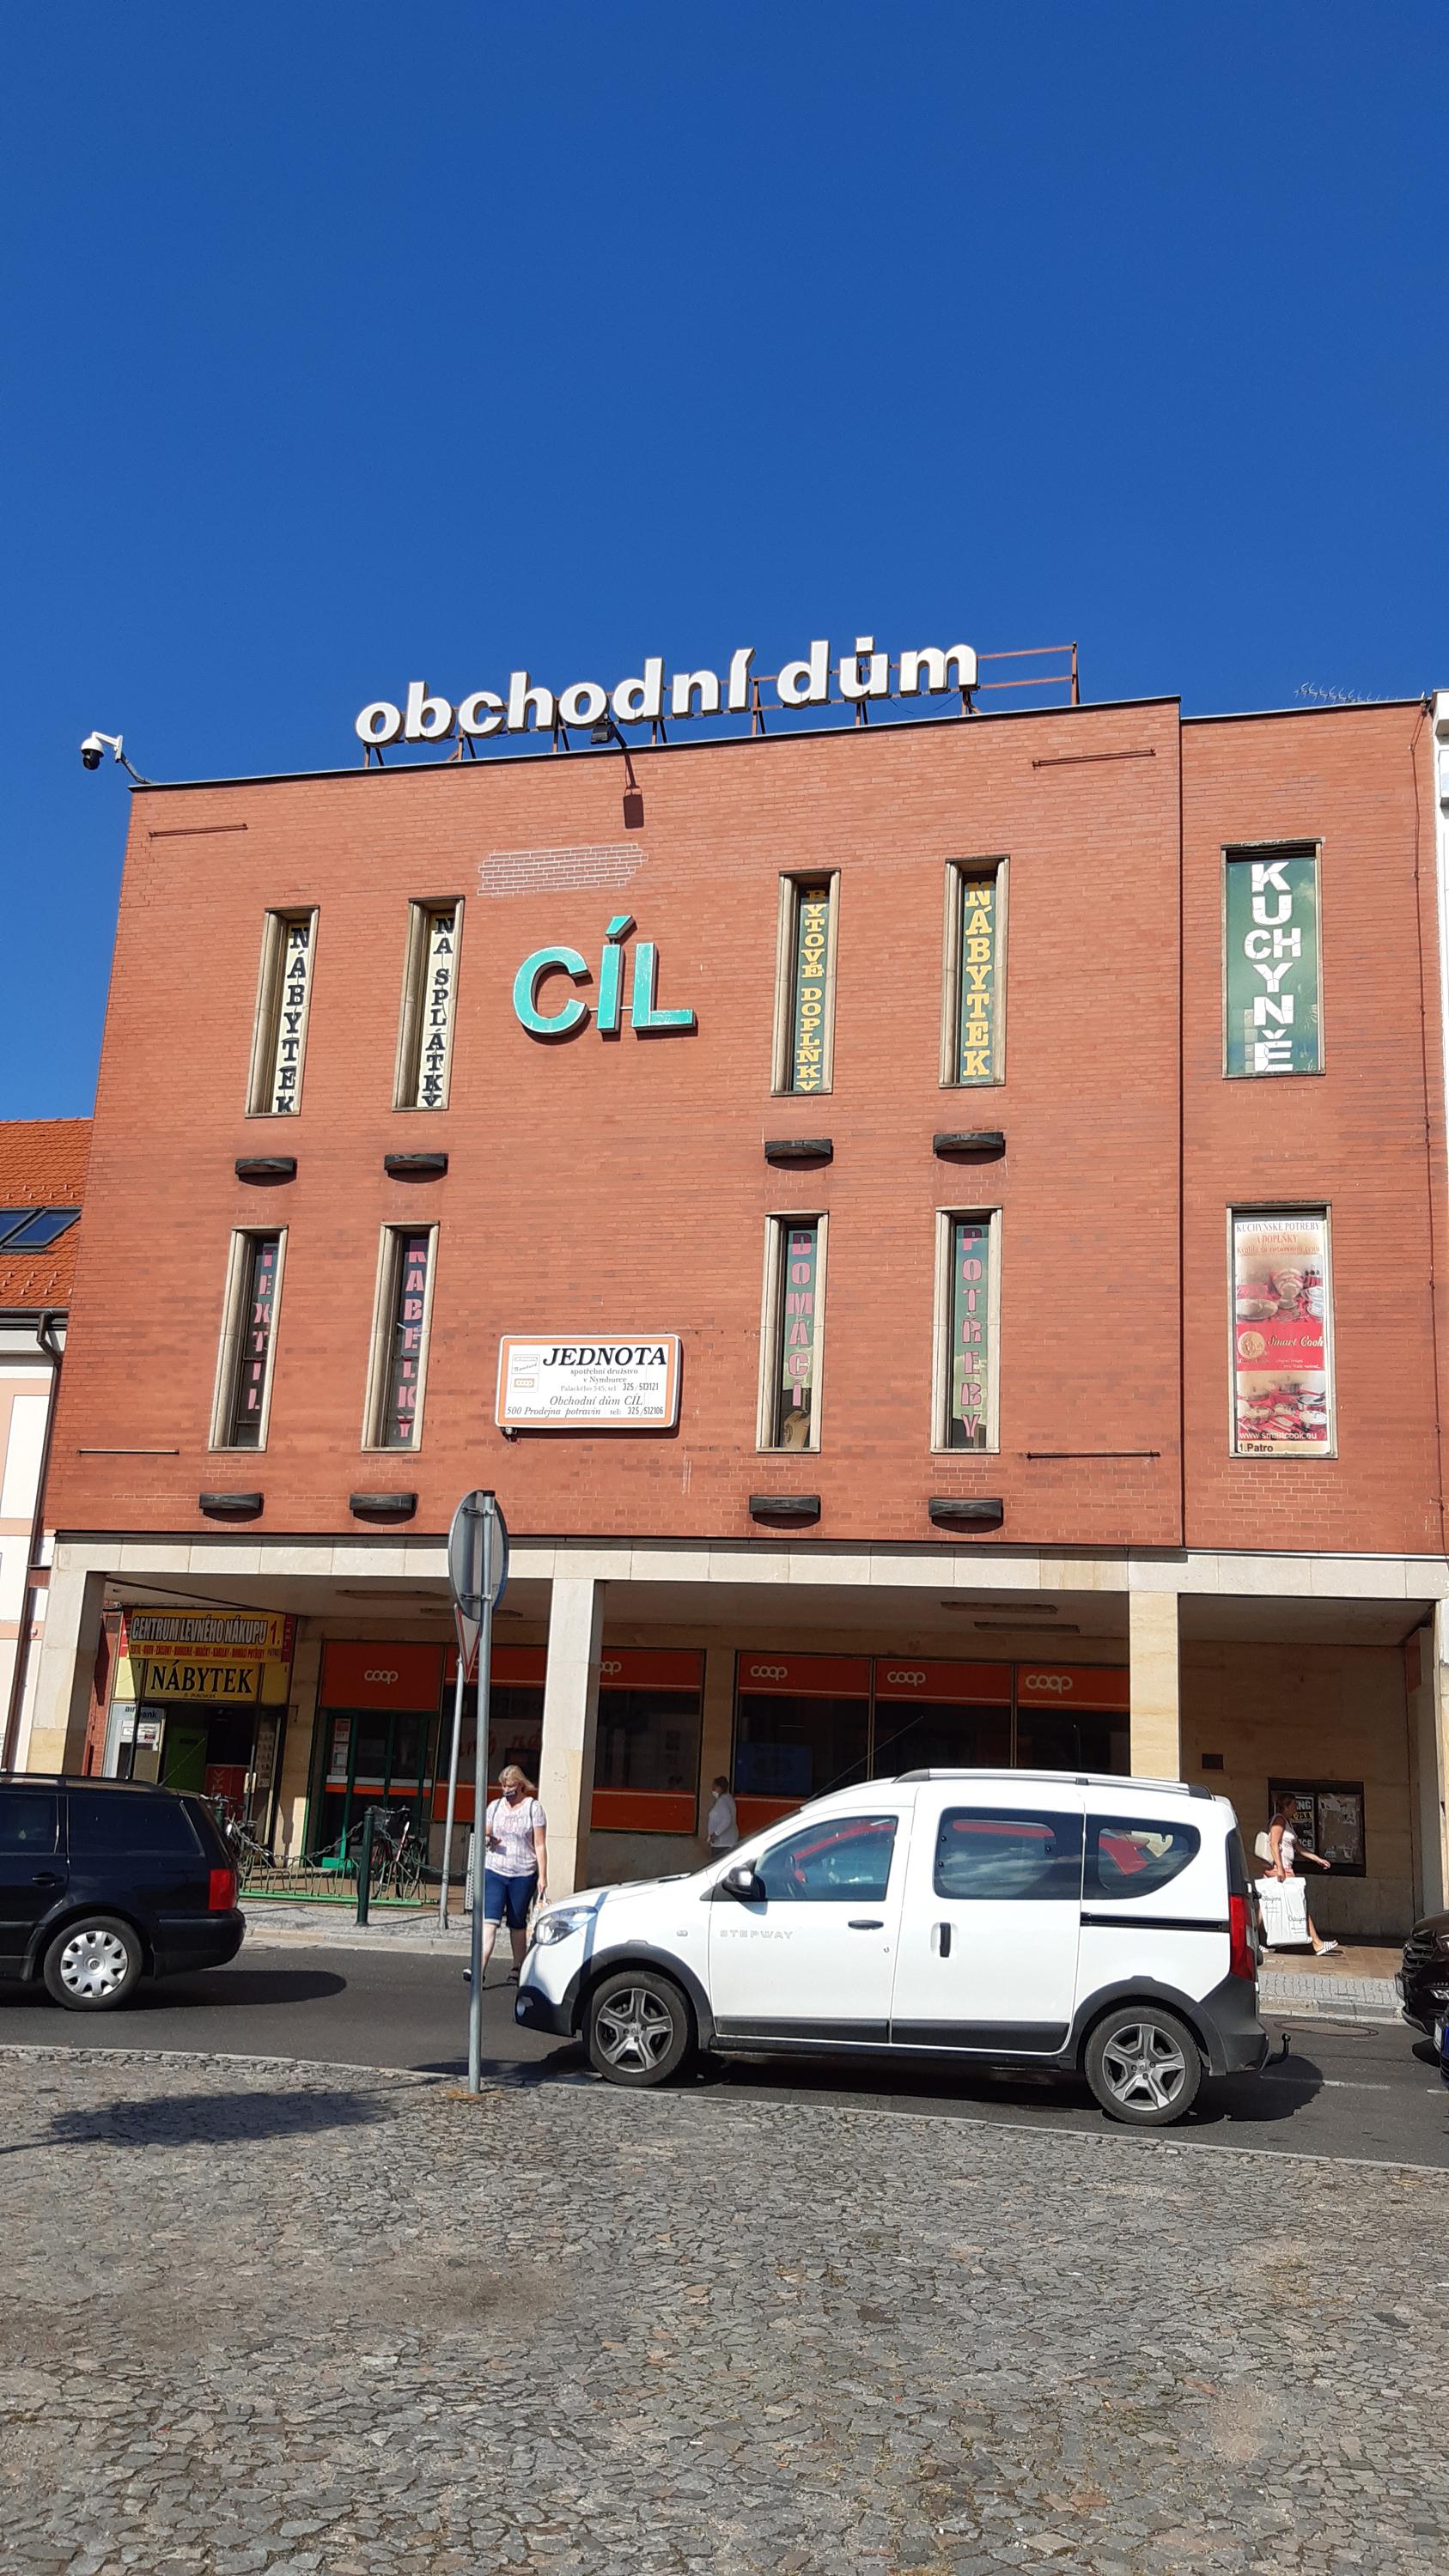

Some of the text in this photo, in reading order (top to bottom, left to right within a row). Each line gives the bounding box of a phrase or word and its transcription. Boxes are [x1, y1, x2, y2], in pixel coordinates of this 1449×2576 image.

[355, 636, 979, 747] obchodní dům
[513, 914, 696, 1034] CÍL
[1244, 862, 1301, 1072] KUCHYNĚ
[963, 882, 994, 1076] NÁBYTEK
[796, 890, 827, 1091] BYTOVÉ DOPLŇKY
[276, 927, 310, 1112] NÁBYTEK
[786, 1233, 813, 1406] DOMÁCÍ
[543, 1347, 667, 1366] JEDNOTA
[589, 1376, 627, 1385] Nymburce
[550, 1393, 642, 1406] Obchodní dům CÍL
[524, 1406, 561, 1419] Prodejna
[131, 1616, 180, 1642] CENTRUM
[180, 1614, 223, 1643] LEVNÉHO
[224, 1614, 268, 1645] NÁKUPU
[150, 1659, 253, 1694] NÁBYTEK
[364, 1669, 399, 1684] coop
[600, 1661, 622, 1675] oop
[750, 1665, 788, 1681] coop
[887, 1670, 926, 1686] coop
[1025, 1674, 1073, 1694] coop
[140, 1710, 158, 1718] ank
[720, 1929, 793, 1940] STEPWAY
